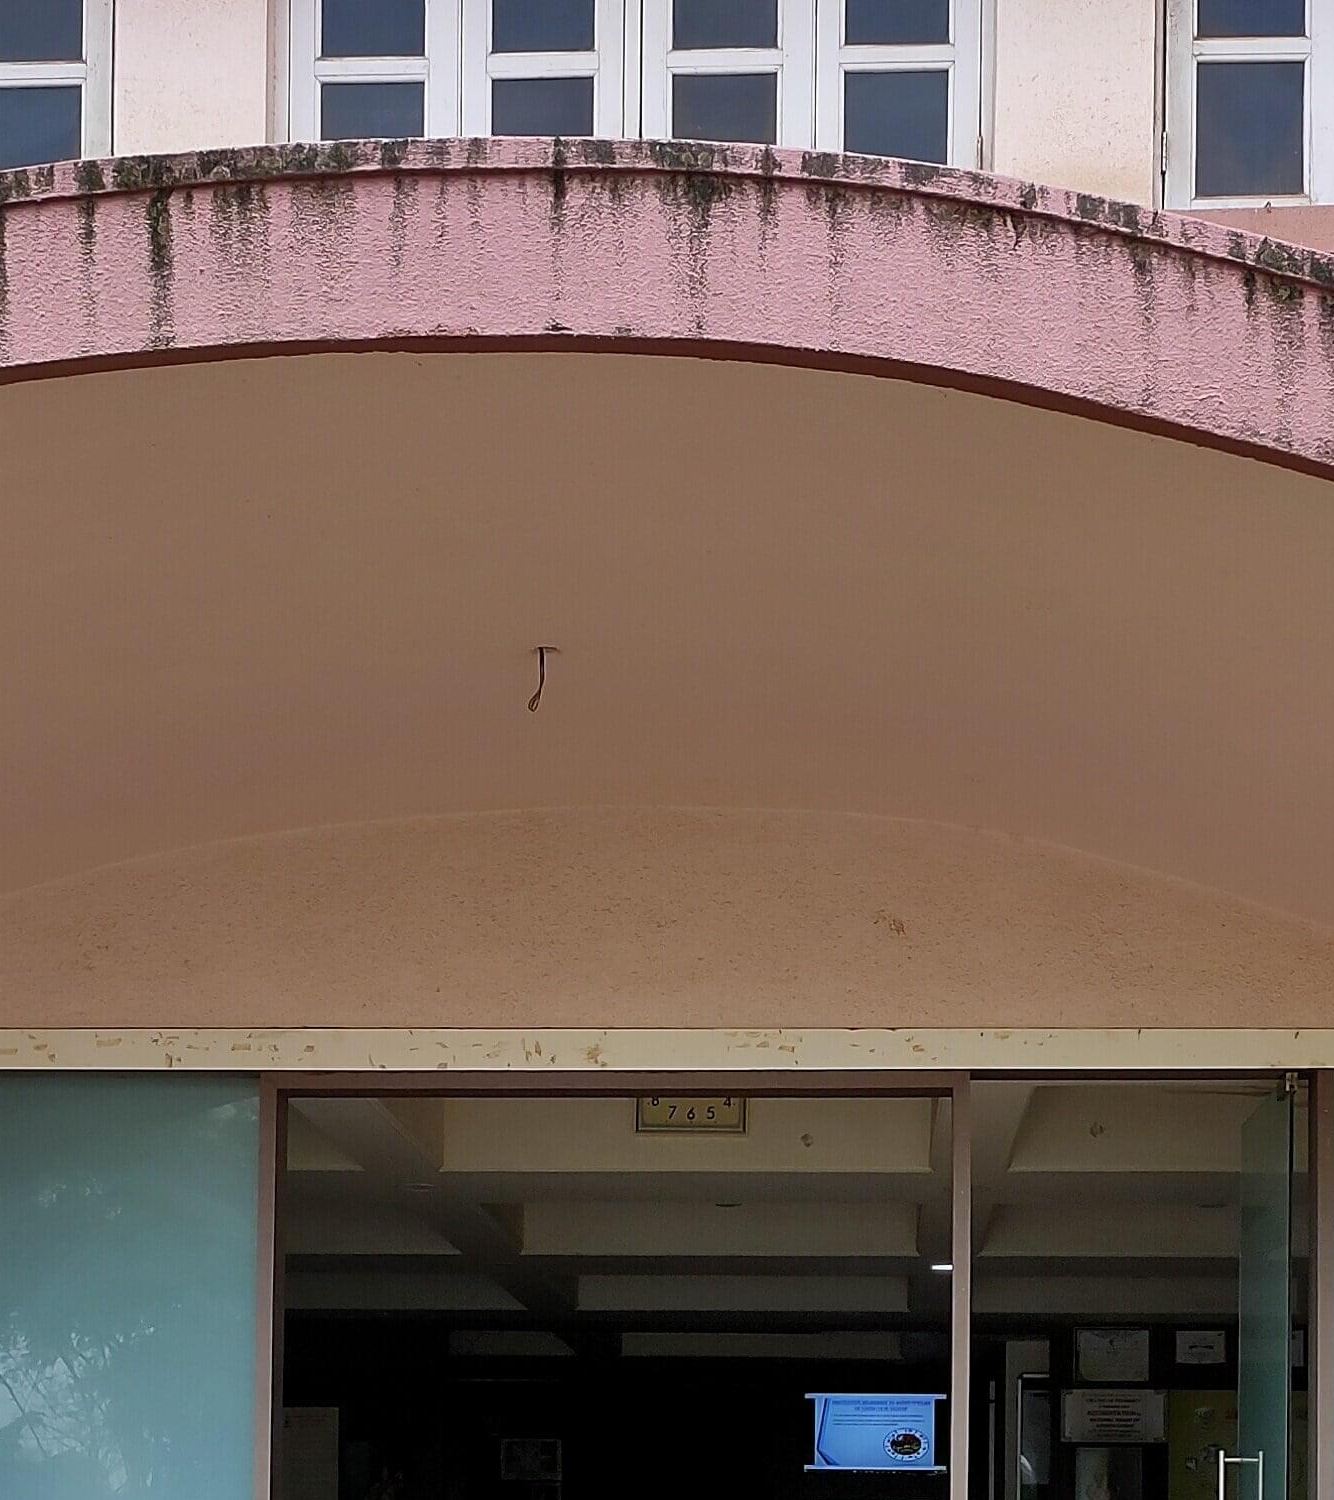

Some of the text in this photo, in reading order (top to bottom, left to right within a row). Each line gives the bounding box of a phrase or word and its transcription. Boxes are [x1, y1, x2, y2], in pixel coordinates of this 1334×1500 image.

[669, 1105, 715, 1120] 7 6 5
